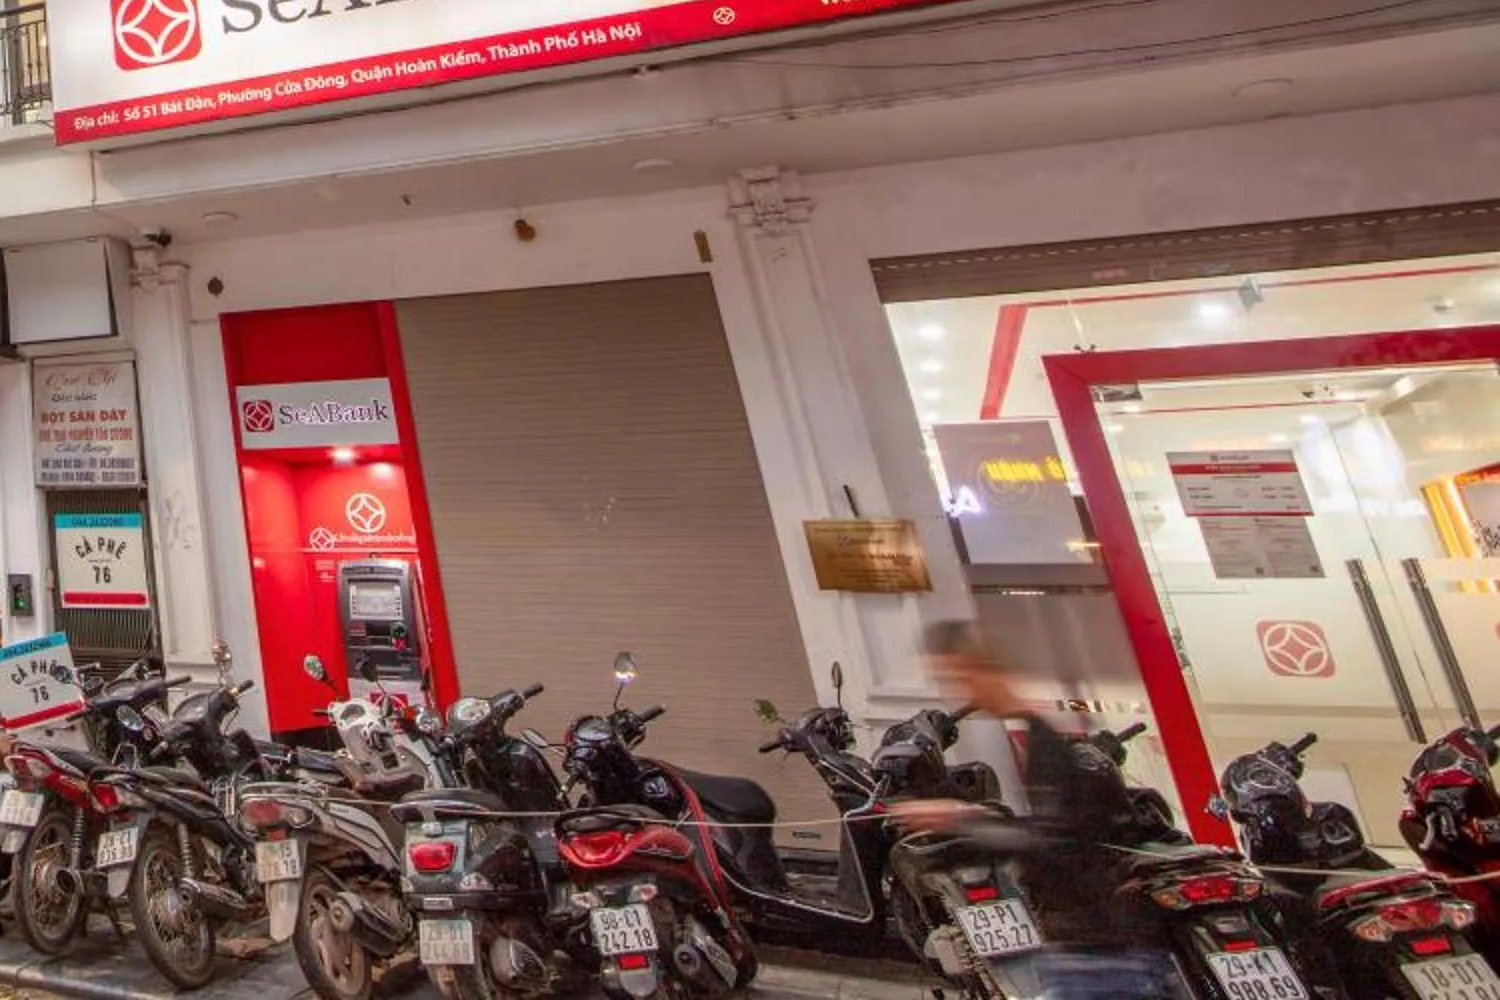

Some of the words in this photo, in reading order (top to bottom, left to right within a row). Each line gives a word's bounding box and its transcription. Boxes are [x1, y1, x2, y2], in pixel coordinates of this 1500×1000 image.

[218, 84, 273, 106] Phường
[351, 64, 393, 84] Quận
[395, 57, 437, 77] Hoàn
[488, 39, 542, 60] Thành
[543, 30, 580, 51] Phố
[581, 28, 608, 45] Hà
[610, 21, 642, 43] Nội
[279, 400, 389, 425] SeABank
[93, 565, 111, 585] 76
[32, 685, 50, 704] 76
